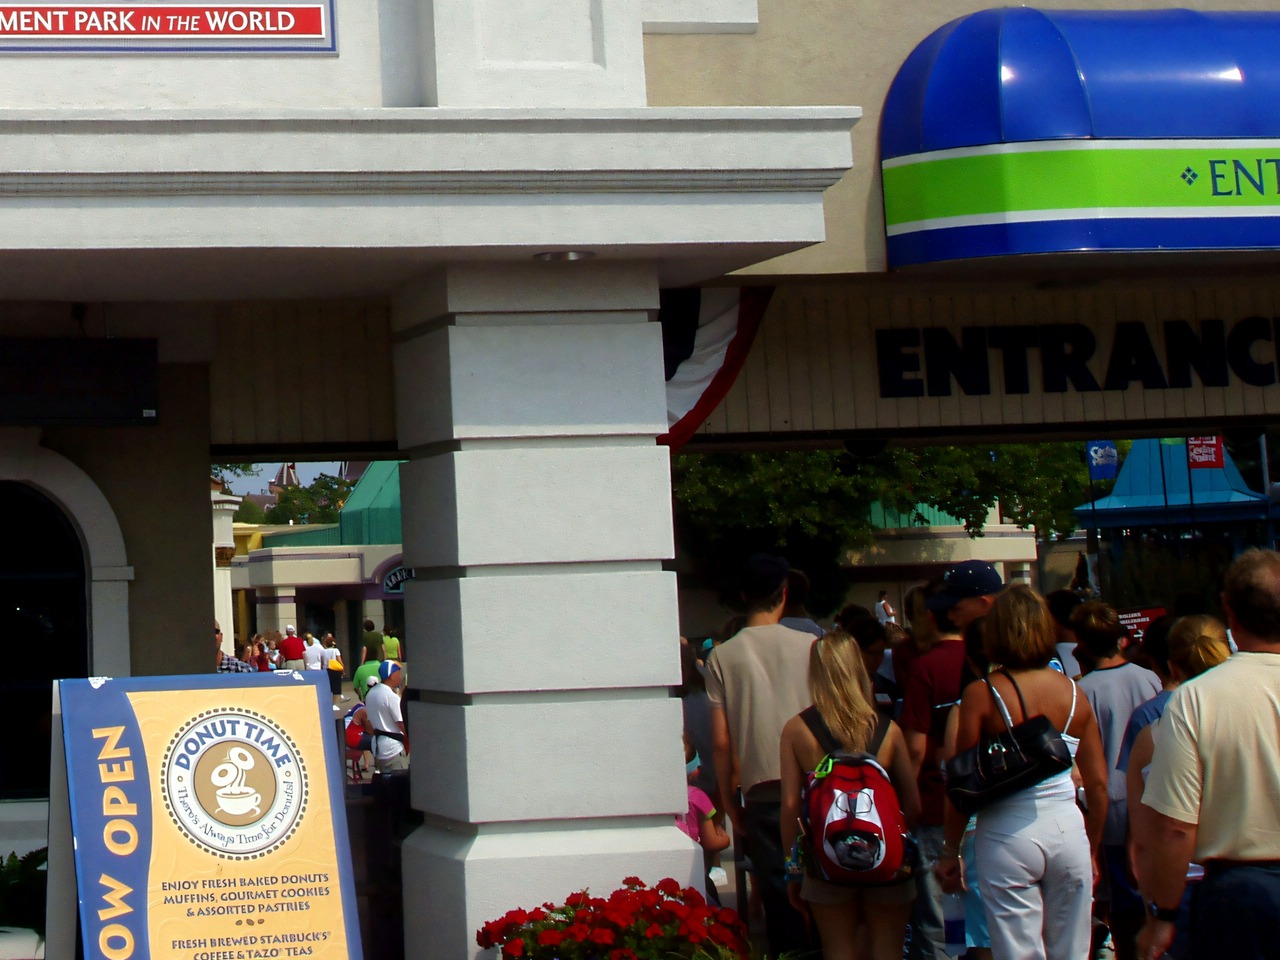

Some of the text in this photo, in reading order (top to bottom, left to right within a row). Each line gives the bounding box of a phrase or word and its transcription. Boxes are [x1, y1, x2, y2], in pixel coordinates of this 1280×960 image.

[75, 10, 137, 31] PARK
[141, 15, 161, 31] IN
[166, 15, 200, 31] THE
[204, 10, 295, 31] WORLD
[875, 316, 1280, 398] ENTRANC
[175, 719, 291, 770] DONUT TIME
[91, 725, 139, 856] OPEN
[199, 823, 235, 848] Always
[261, 821, 277, 840] for
[162, 873, 329, 891] ENJOY FRESH BAKED DONUTS
[163, 886, 330, 905] MUFFINS, GOURMET COOKIES
[186, 901, 311, 917] & ASSORTED PASTRIES
[172, 938, 207, 950] FRESH
[210, 935, 258, 948] BREWED
[236, 950, 245, 960] &
[285, 945, 313, 957] TEAS
